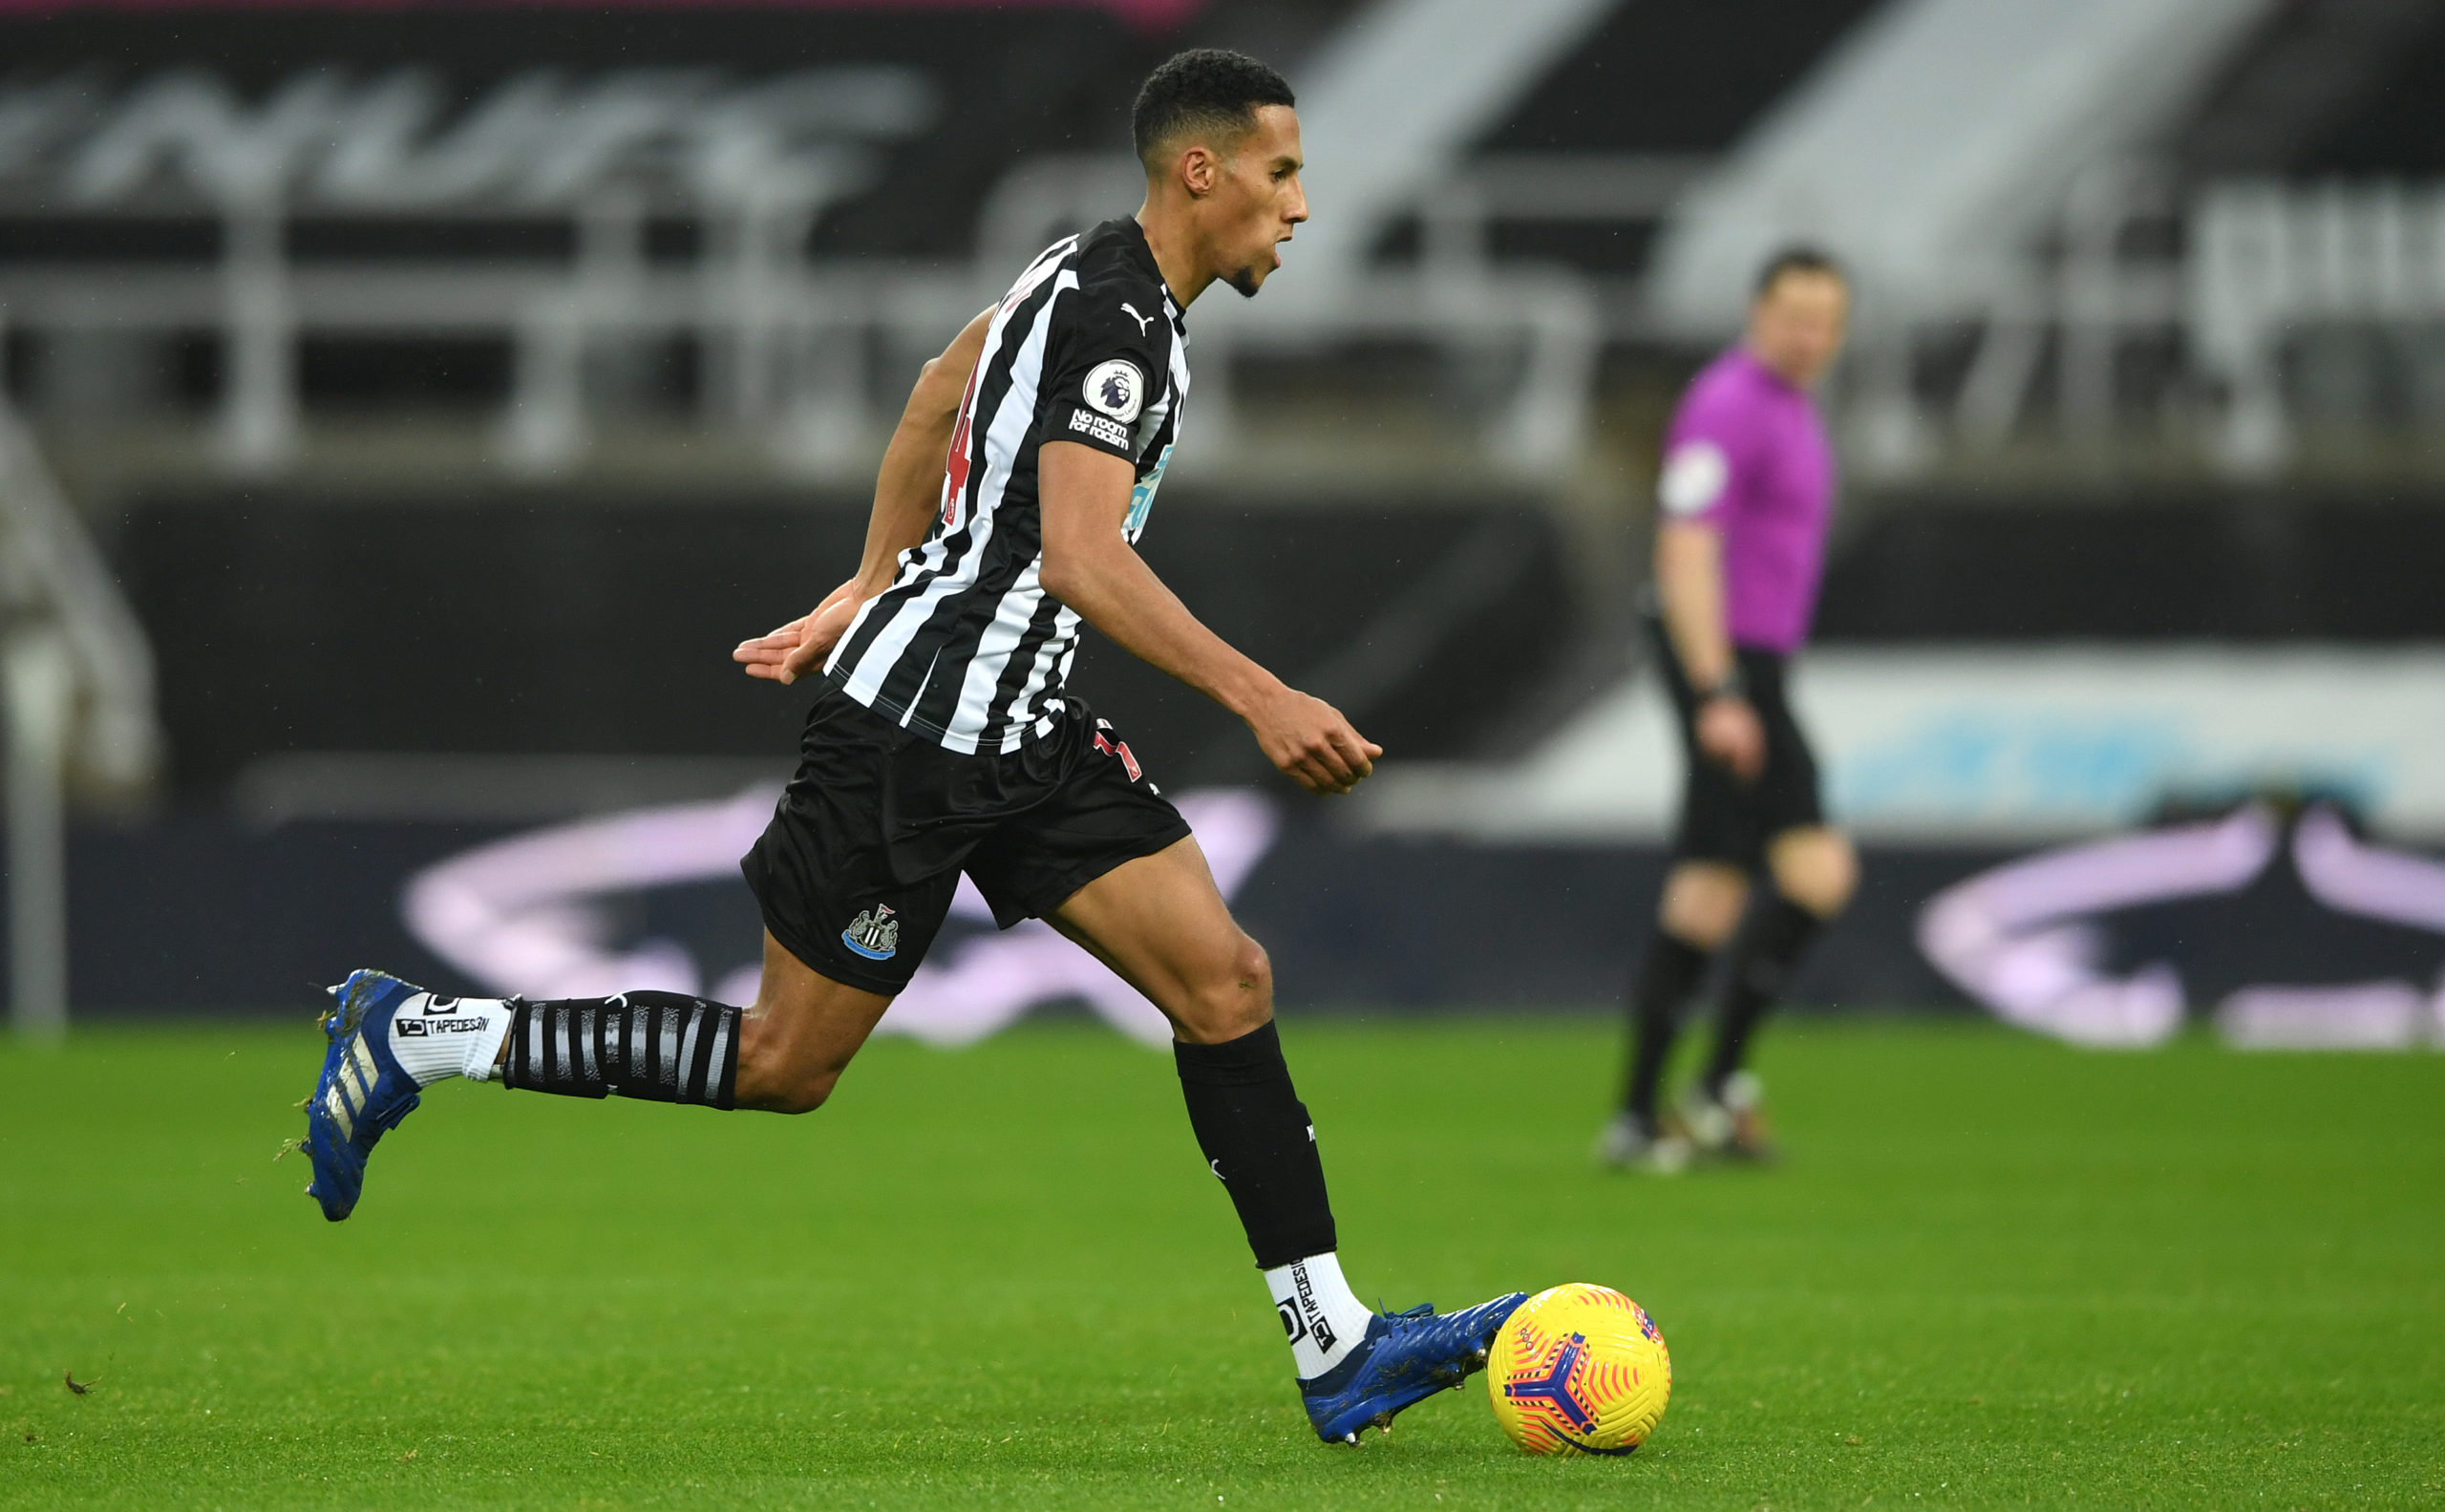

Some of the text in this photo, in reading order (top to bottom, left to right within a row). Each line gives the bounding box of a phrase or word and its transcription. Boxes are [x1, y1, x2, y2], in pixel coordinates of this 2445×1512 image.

[1068, 418, 1129, 451] for racism
[1072, 408, 1093, 424] No
[1093, 416, 1128, 438] room
